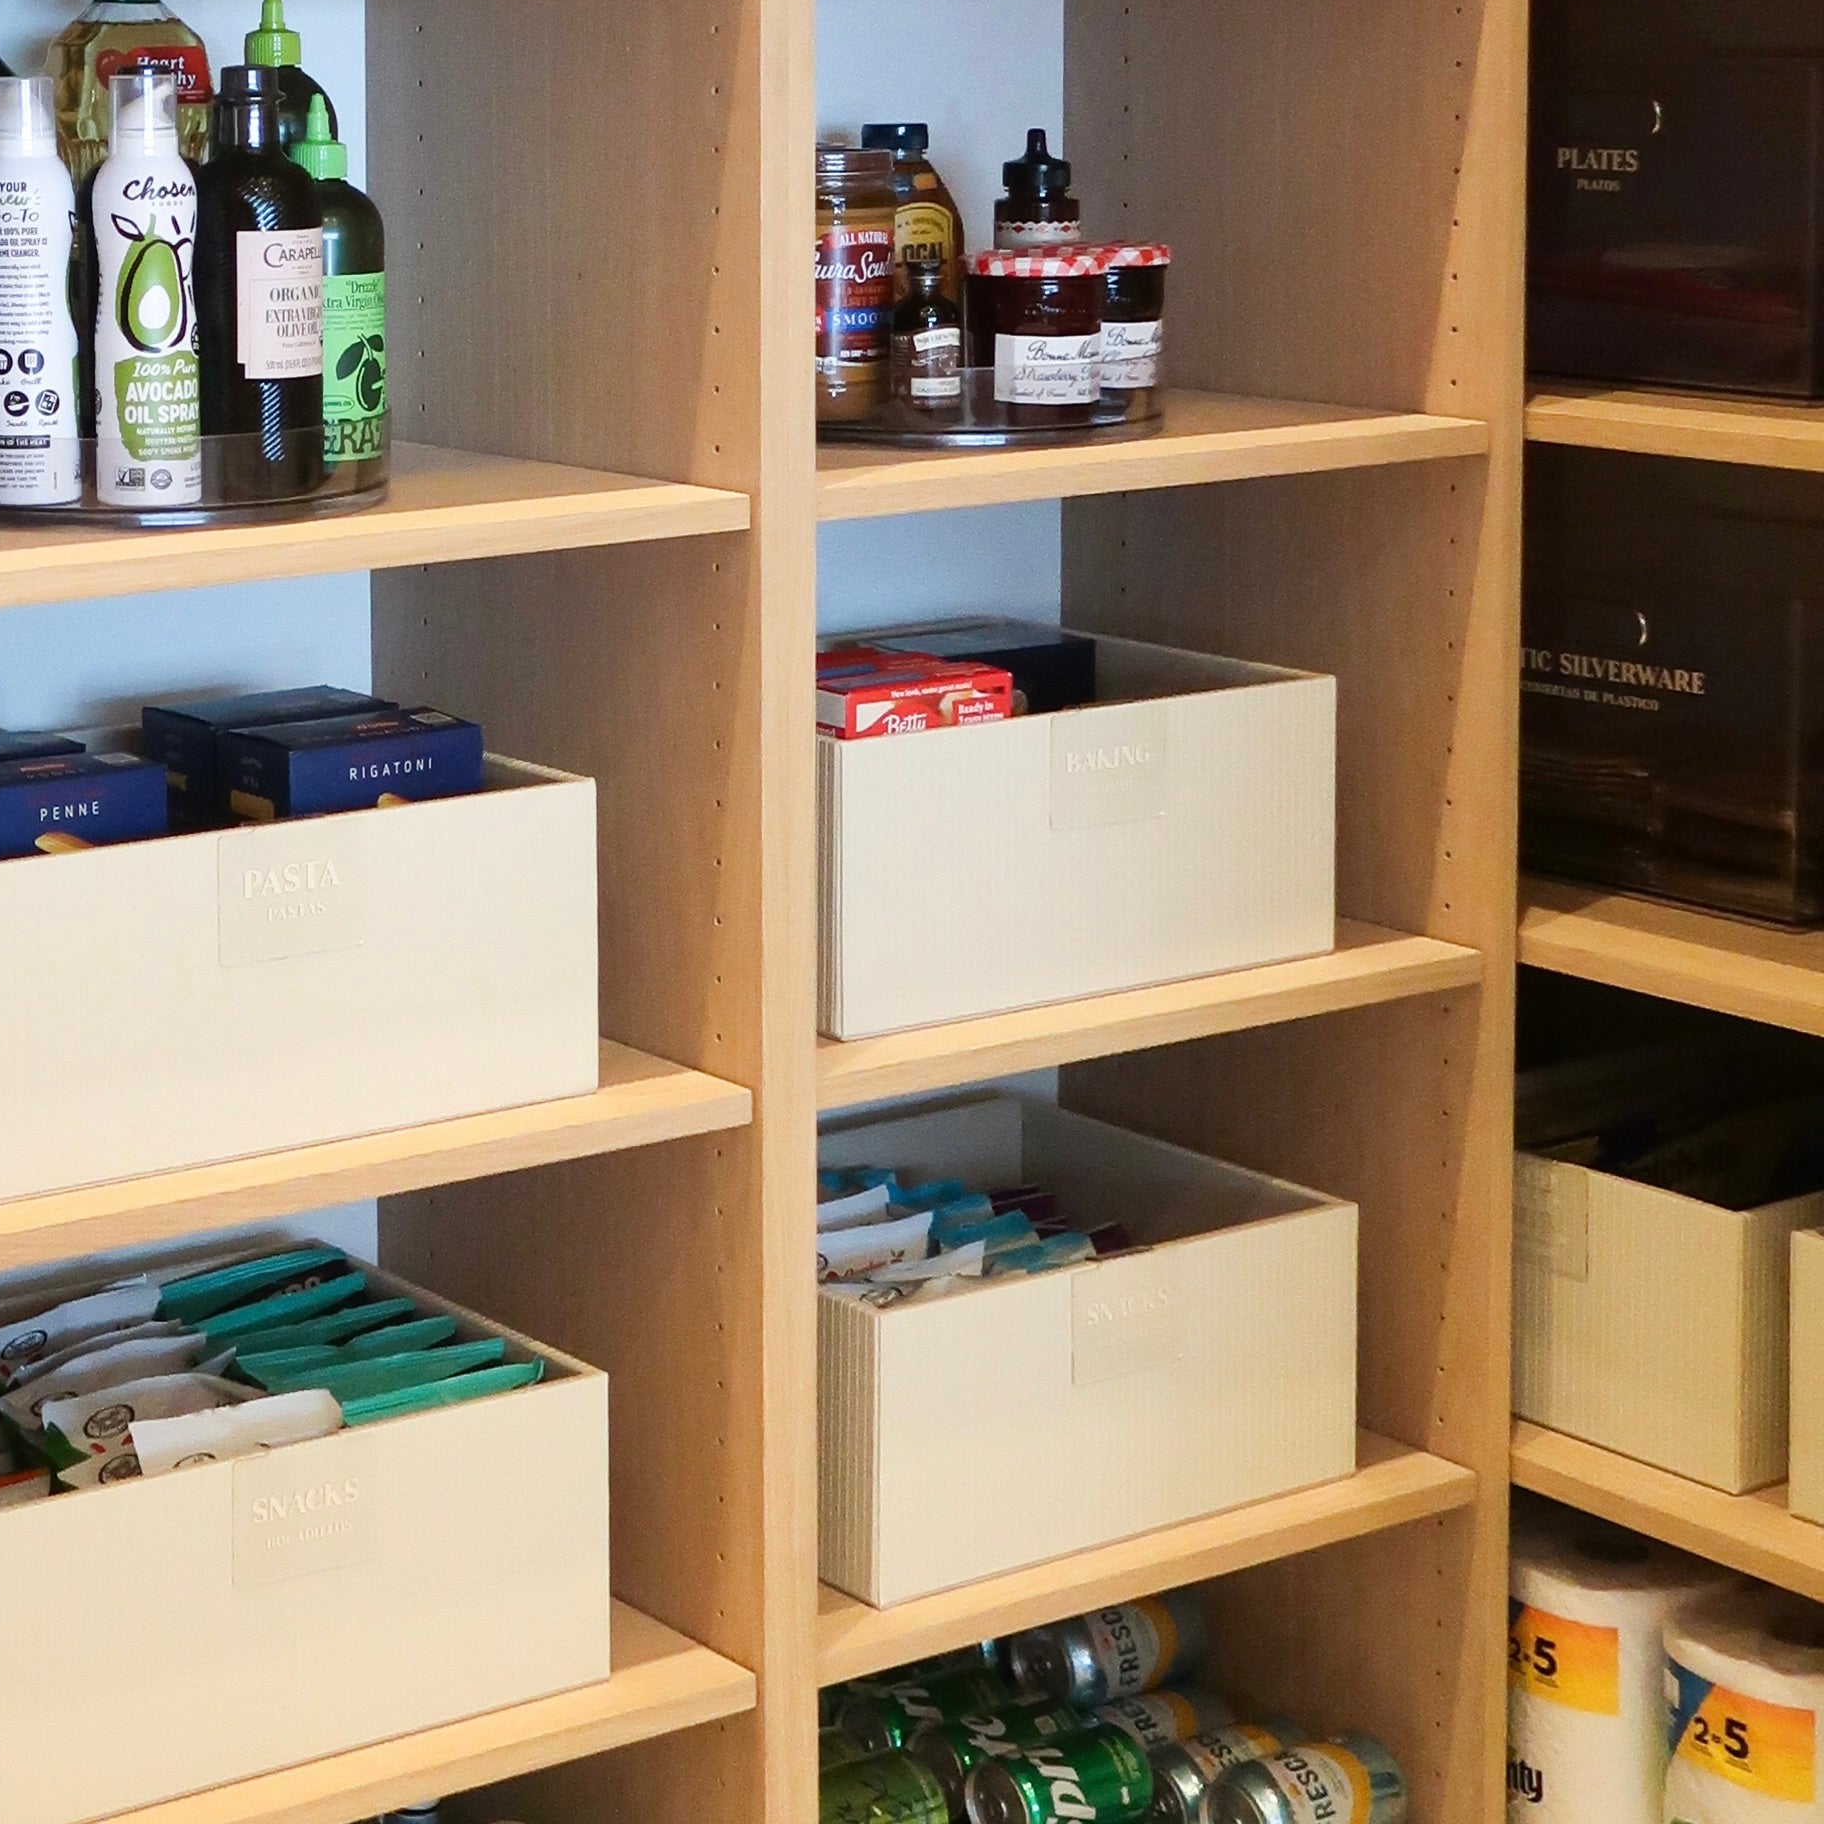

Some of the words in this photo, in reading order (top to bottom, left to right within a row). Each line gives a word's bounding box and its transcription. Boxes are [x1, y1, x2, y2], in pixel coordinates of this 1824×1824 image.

[1557, 147, 1637, 173] PLATES
[0, 181, 27, 193] YOUR
[122, 176, 196, 201] Chosen
[21, 227, 38, 236] PURE
[840, 234, 857, 246] ALL
[1027, 340, 1074, 361] Bonne
[133, 361, 171, 377] 100%
[125, 378, 197, 403] AVOCADO
[124, 405, 154, 424] OIL
[1560, 653, 1706, 695] SILVERWARE
[958, 701, 984, 715] Ready
[1583, 690, 1599, 702] DE
[1602, 692, 1660, 712] PLASTICO
[882, 713, 927, 736] Betty
[348, 757, 434, 782] RIGATONI
[1064, 743, 1150, 774] BAKING
[39, 800, 102, 823] PENNE
[241, 858, 339, 900] PASTA
[251, 1477, 360, 1525] SNACKS
